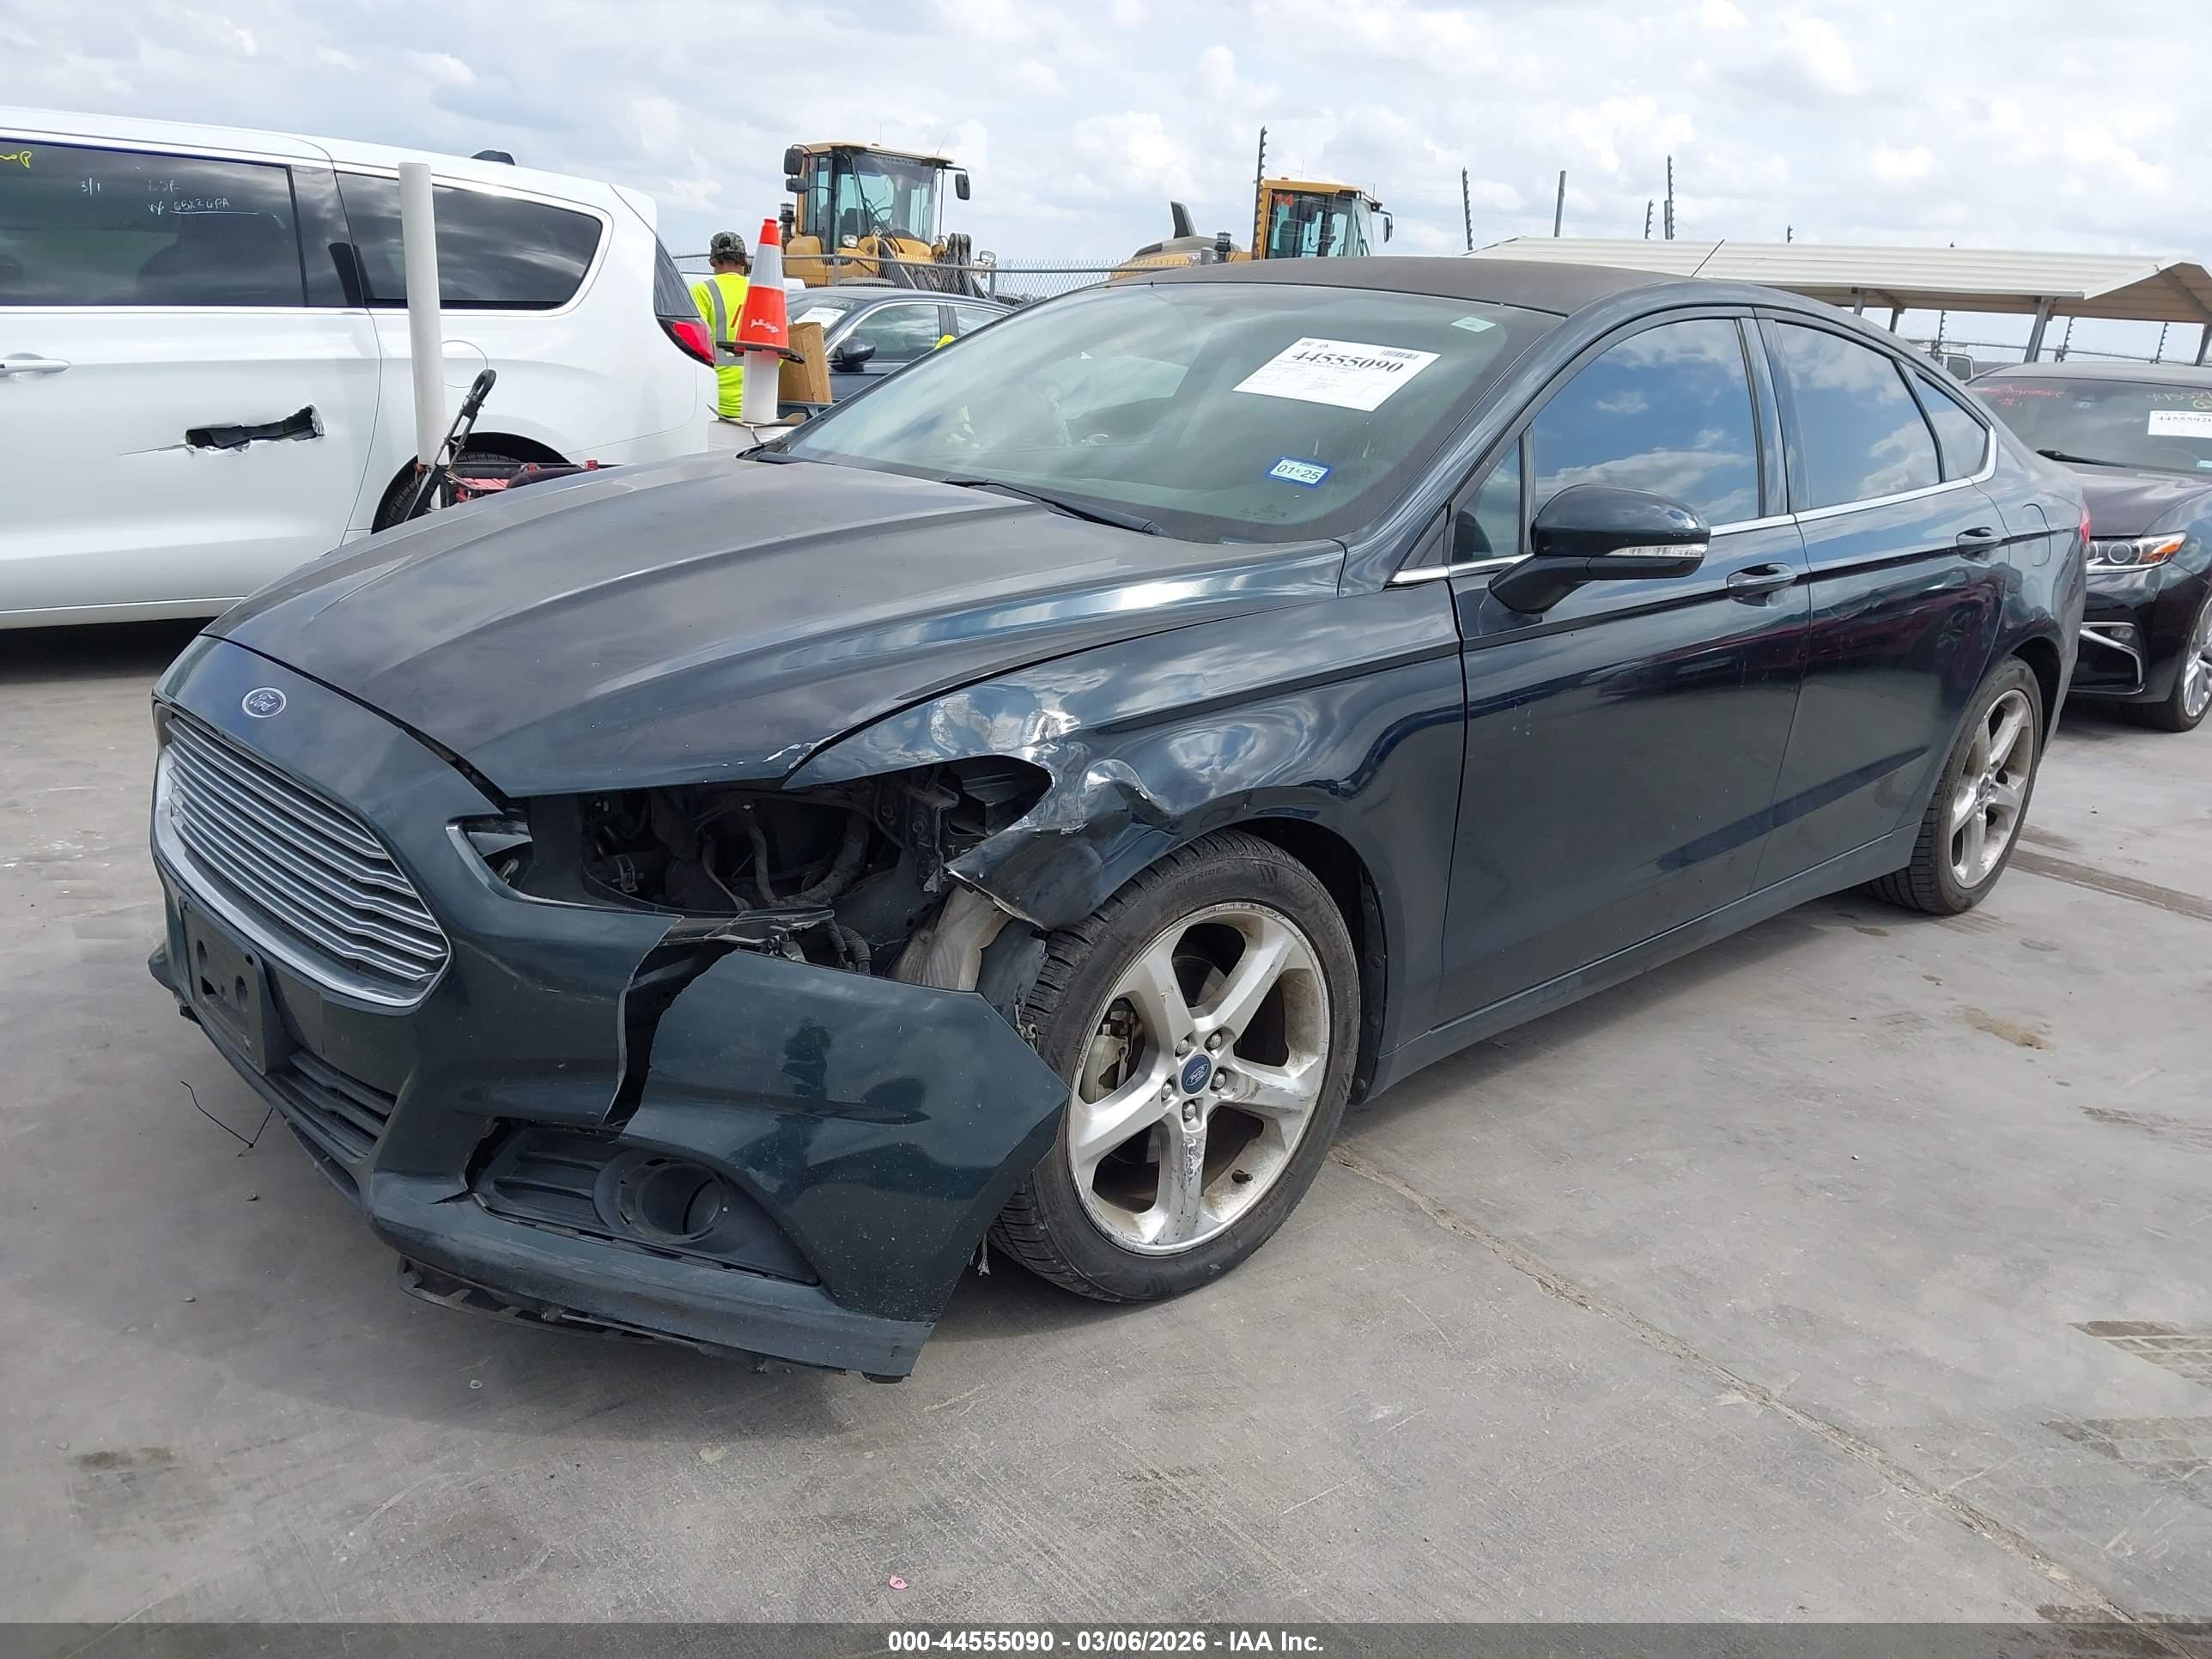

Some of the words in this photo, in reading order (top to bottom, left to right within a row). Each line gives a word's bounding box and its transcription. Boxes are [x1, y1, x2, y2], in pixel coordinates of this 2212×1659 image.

[1291, 350, 1405, 374] 44555090
[1277, 465, 1296, 475] 01
[1299, 470, 1322, 480] 25
